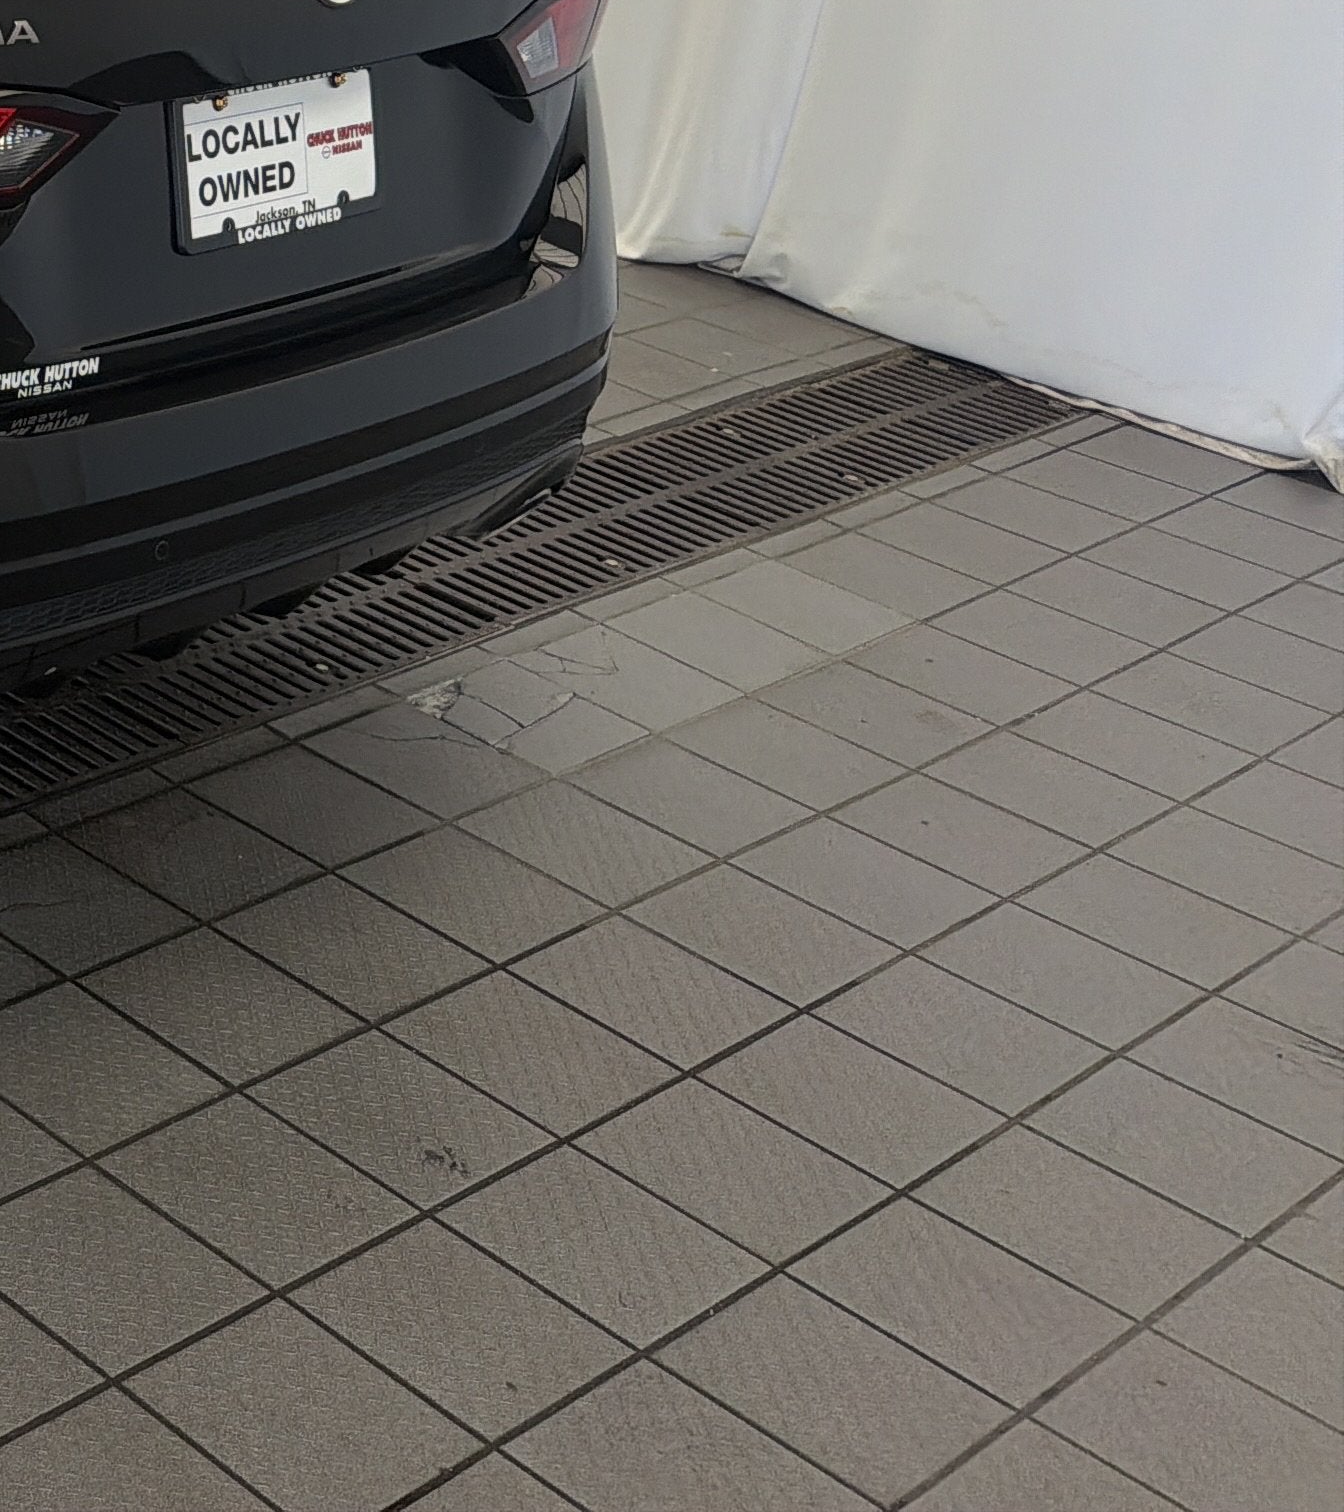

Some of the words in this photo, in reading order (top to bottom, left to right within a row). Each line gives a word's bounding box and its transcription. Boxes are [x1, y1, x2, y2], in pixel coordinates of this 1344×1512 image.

[186, 111, 301, 163] LOCALLY
[198, 160, 296, 207] OWNED
[302, 197, 316, 214] TN
[237, 218, 292, 245] LOCALLY
[295, 207, 342, 230] OWNED
[44, 356, 100, 383] HUTTON
[17, 379, 73, 399] NISSAN
